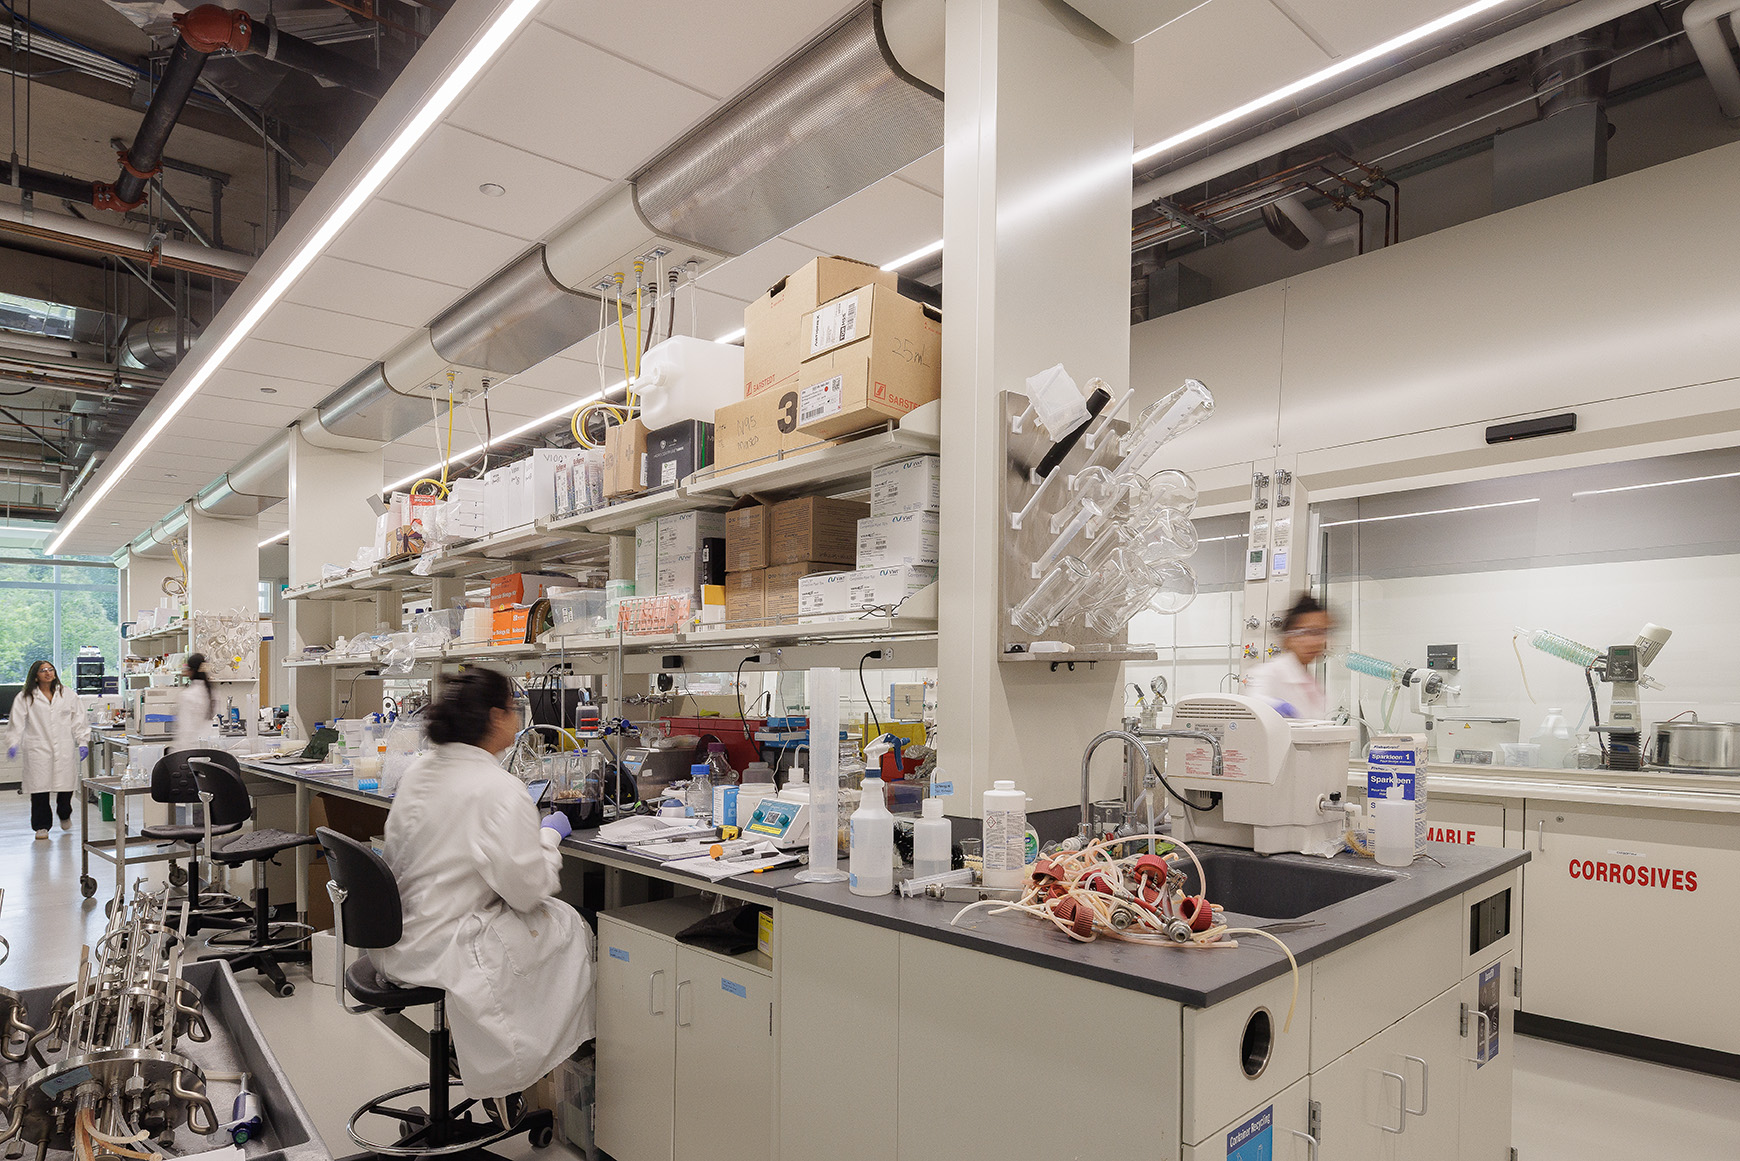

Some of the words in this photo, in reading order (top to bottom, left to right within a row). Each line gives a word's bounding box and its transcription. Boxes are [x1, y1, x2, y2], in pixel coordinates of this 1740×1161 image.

[777, 391, 799, 434] 3
[888, 393, 921, 410] SARSTE
[1370, 775, 1411, 784] Sparkeen
[1426, 827, 1476, 845] MABLE
[1569, 858, 1699, 893] CORROSIVES
[1229, 1127, 1251, 1148] Container
[1250, 1113, 1271, 1134] Recycling
